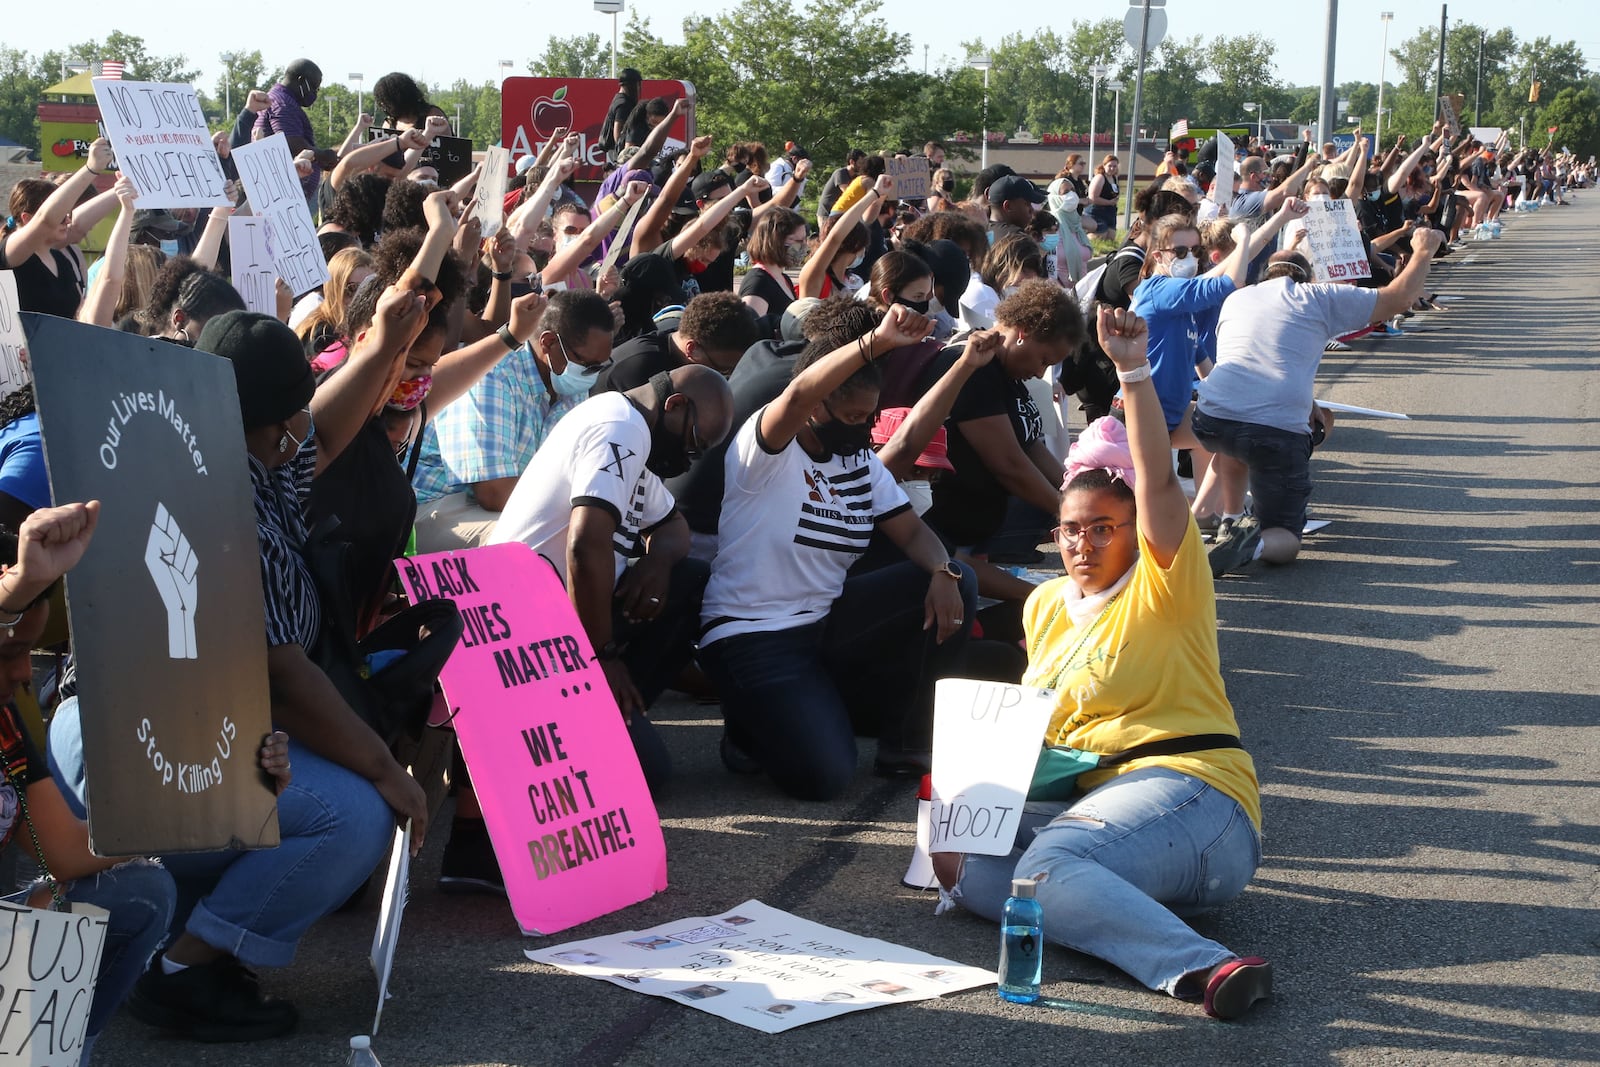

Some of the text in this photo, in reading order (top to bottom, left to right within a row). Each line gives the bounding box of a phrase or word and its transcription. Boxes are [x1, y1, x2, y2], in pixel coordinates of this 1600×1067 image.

[107, 86, 205, 130] NO JUSTICE
[125, 151, 162, 196] NO
[244, 147, 303, 209] BLACK
[271, 202, 315, 254] LIVES
[1323, 200, 1345, 212] BLACK
[245, 223, 259, 268] I
[274, 247, 326, 293] MATTER
[1327, 264, 1347, 278] BLEED
[100, 389, 208, 476] Our Lives Matter
[598, 441, 637, 482] X
[405, 557, 480, 600] BLACK
[459, 602, 512, 648] LIVES
[493, 634, 589, 689] MATTER
[970, 683, 1022, 724] UP
[136, 717, 174, 786] Stop
[178, 756, 223, 793] Killing
[521, 722, 568, 767] WE
[528, 765, 596, 825] CAN'T
[527, 807, 636, 881] BREATHE!
[689, 952, 801, 982] FOR BEING
[712, 940, 843, 979] KILLED TODAY
[802, 940, 856, 957] HOPE
[809, 955, 850, 968] GET
[681, 962, 743, 981] BLACK
